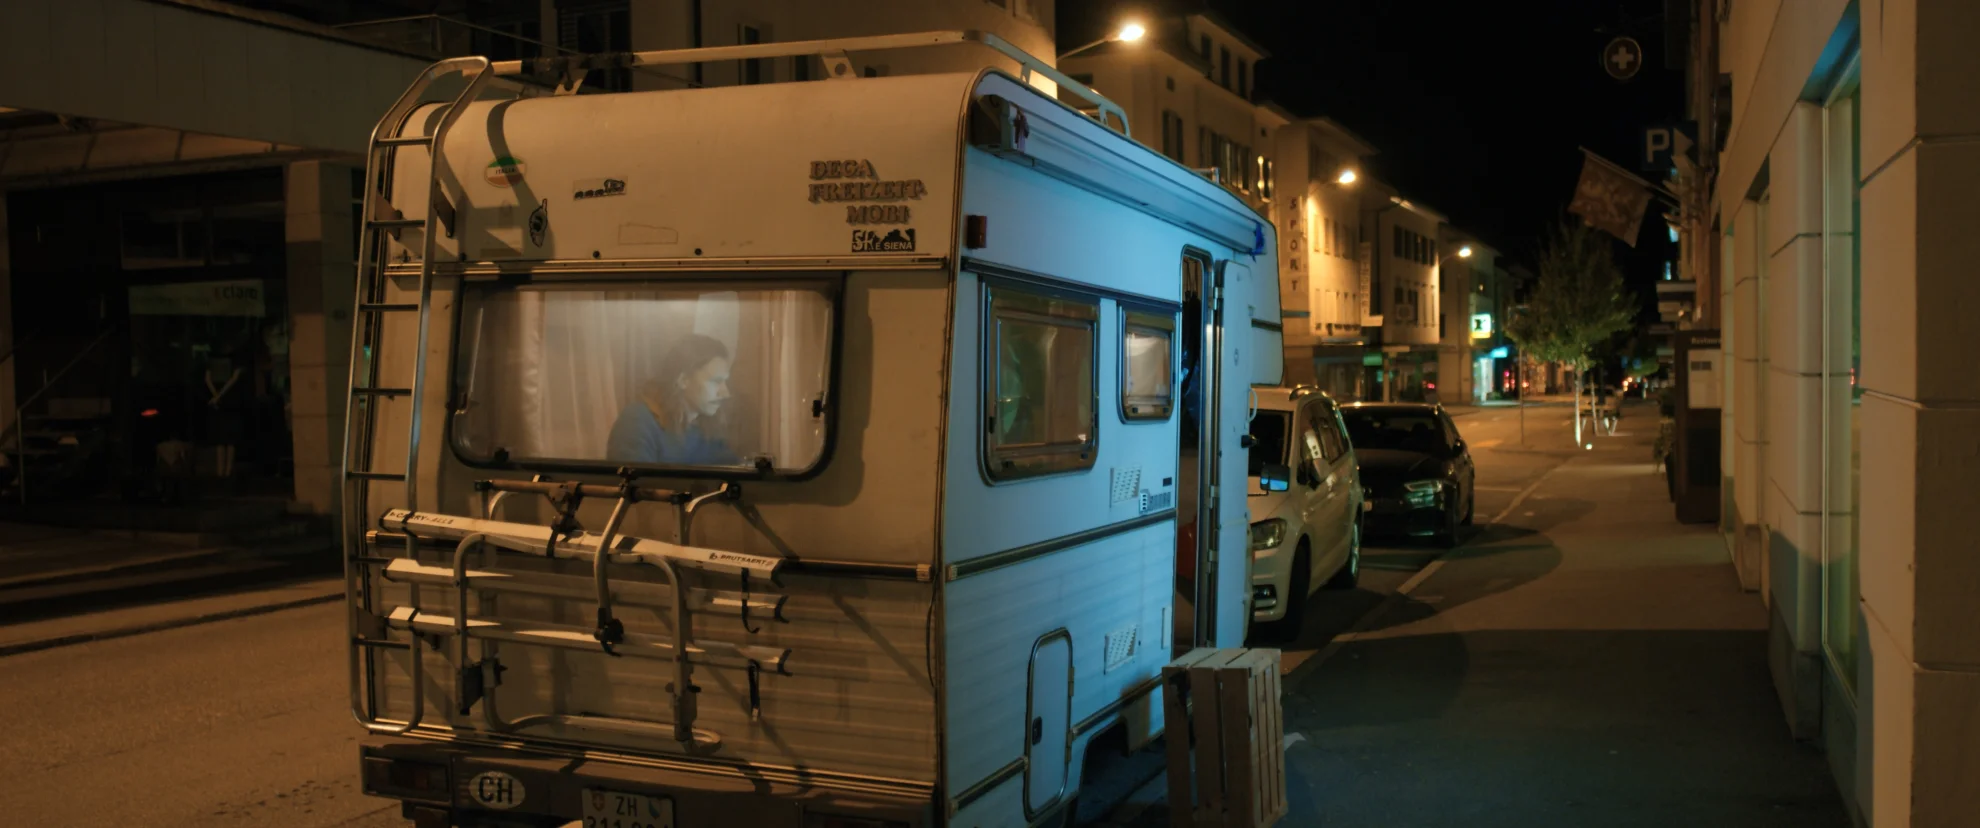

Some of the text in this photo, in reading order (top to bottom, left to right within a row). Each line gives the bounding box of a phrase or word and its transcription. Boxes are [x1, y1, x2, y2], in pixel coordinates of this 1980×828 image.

[1646, 128, 1671, 163] P
[884, 242, 912, 250] SIENA
[1290, 197, 1298, 290] SPORT
[720, 554, 767, 565] BRUTSAERT
[478, 775, 514, 805] CH
[615, 796, 638, 817] ZH
